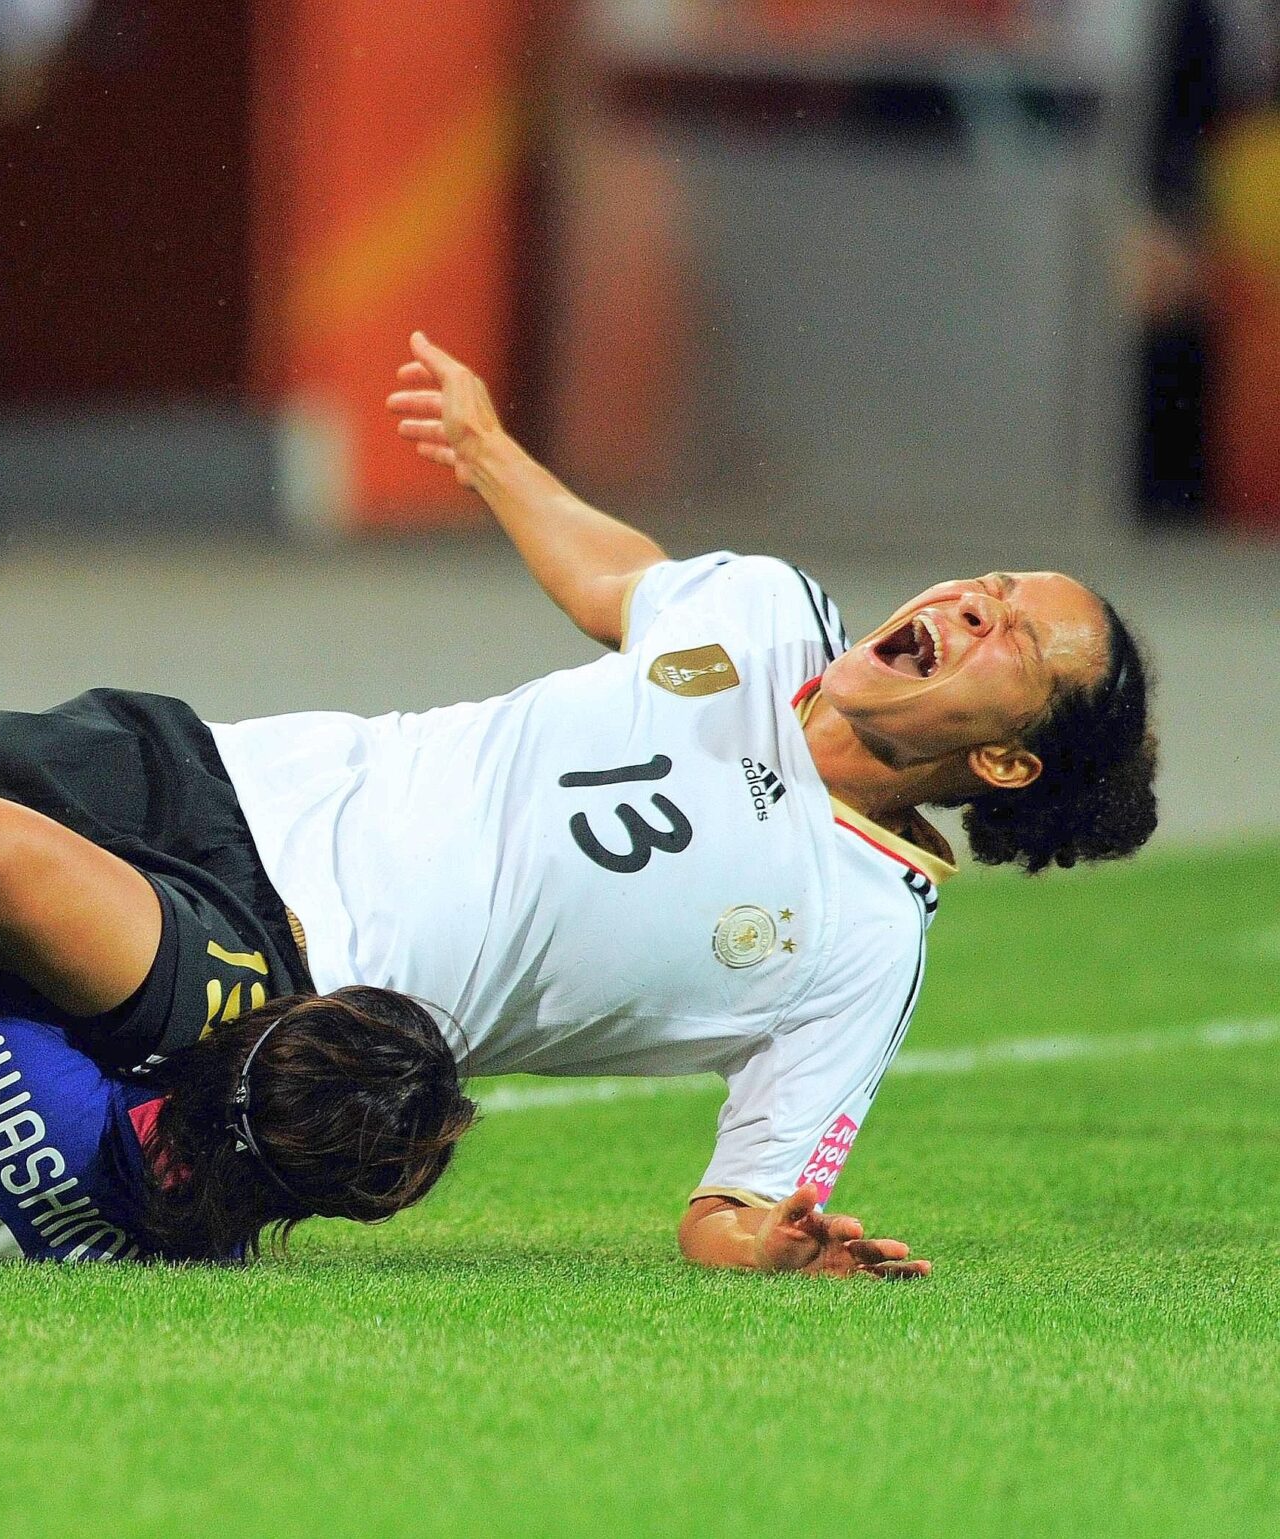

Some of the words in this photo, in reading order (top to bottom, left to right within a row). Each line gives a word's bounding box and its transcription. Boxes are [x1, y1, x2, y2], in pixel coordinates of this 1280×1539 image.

[741, 757, 768, 822] adidas
[558, 754, 693, 874] 13
[823, 1122, 858, 1148] LIV
[816, 1142, 849, 1167] YOU
[803, 1162, 840, 1189] GOA
